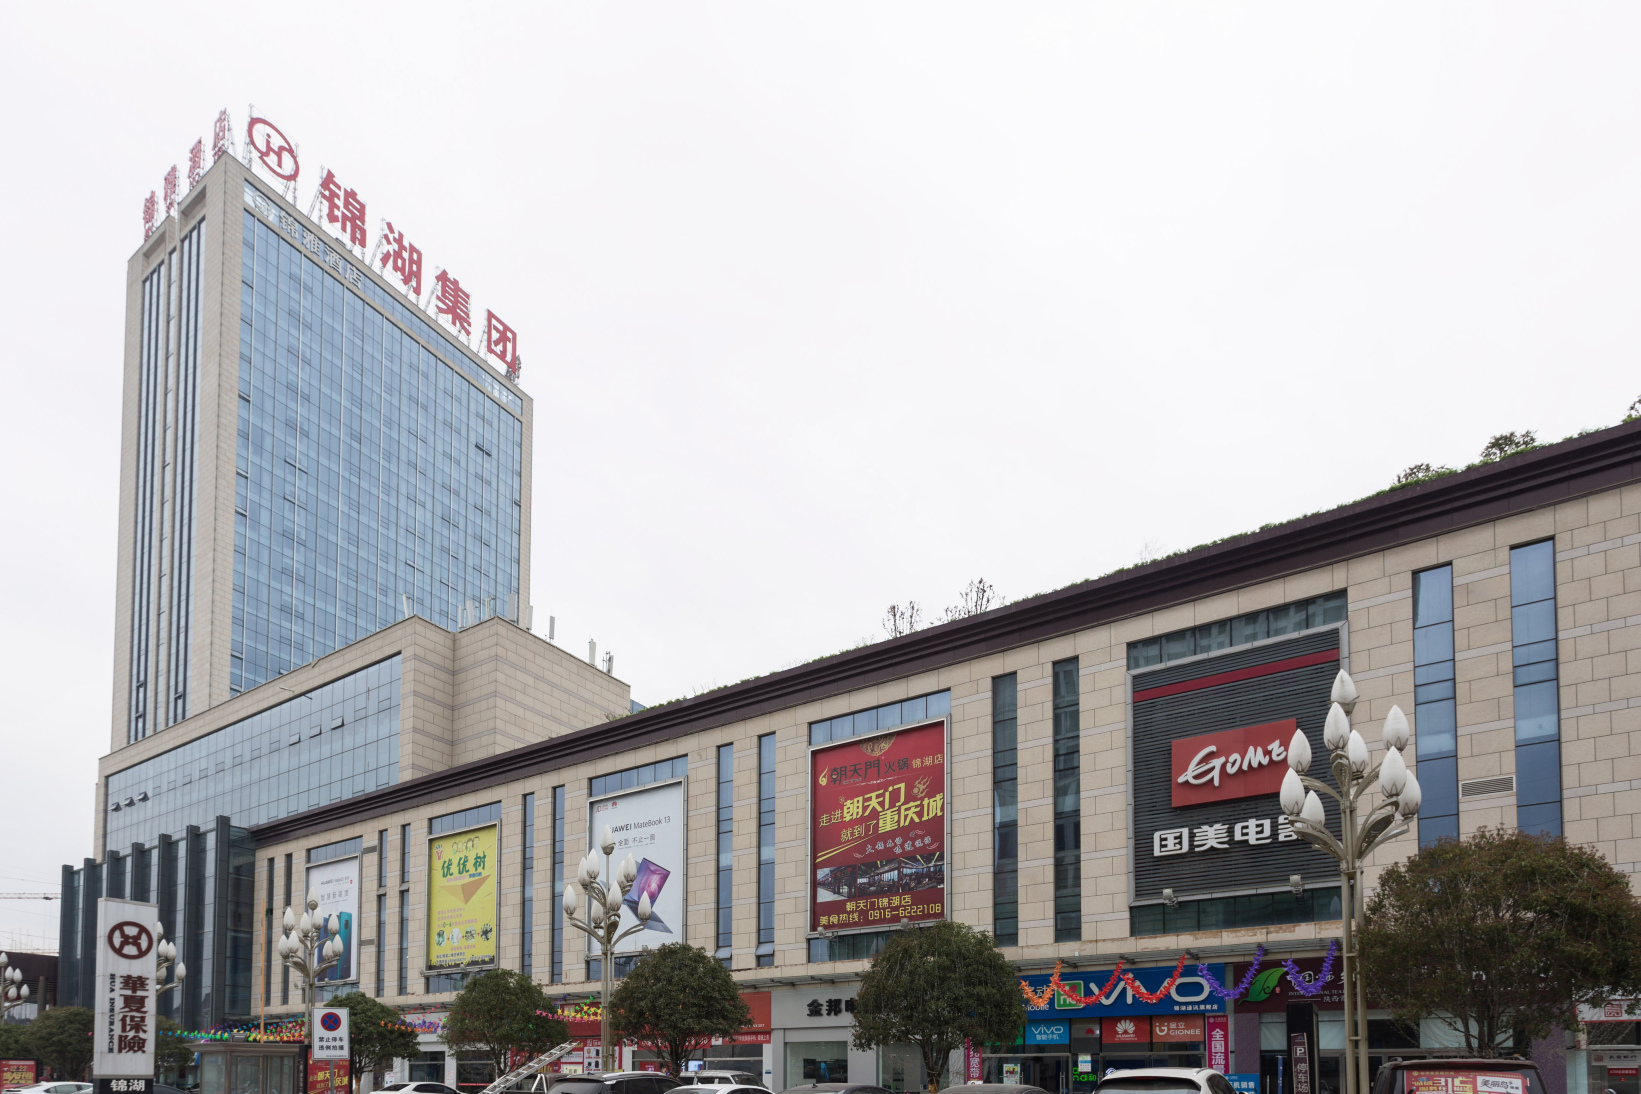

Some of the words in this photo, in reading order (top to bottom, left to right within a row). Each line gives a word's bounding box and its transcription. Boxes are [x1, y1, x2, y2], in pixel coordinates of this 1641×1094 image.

[279, 210, 362, 290] 锦雅酒店
[320, 168, 518, 374] 锦湖集团
[911, 753, 944, 769] 锦湖店
[633, 817, 663, 829] MateBook
[664, 815, 671, 824] 13
[440, 850, 487, 879] 优优树
[845, 894, 912, 912] 朝天门锦湖店
[118, 974, 149, 1054] 華夏保險
[1031, 1024, 1064, 1034] vivo
[1169, 1028, 1201, 1036] GIONEE
[1296, 1047, 1305, 1057] P
[110, 1079, 146, 1092] 锦湖
[1296, 1062, 1309, 1093] 停车场
